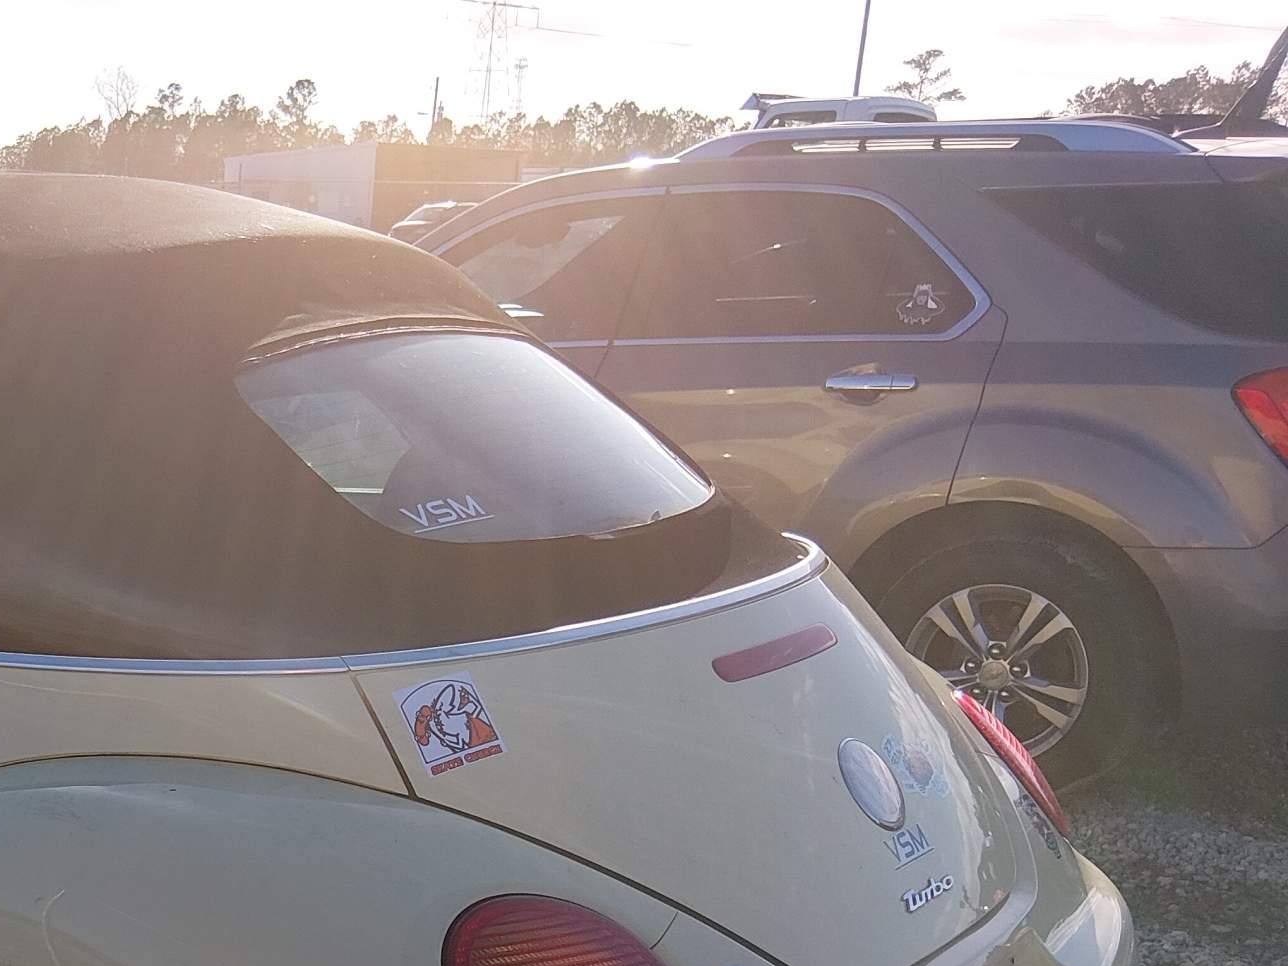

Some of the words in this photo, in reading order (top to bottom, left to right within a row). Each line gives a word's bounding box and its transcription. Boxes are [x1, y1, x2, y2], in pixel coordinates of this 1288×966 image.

[399, 495, 487, 527] VSM
[884, 824, 930, 862] VSM
[902, 874, 953, 913] Turbo
